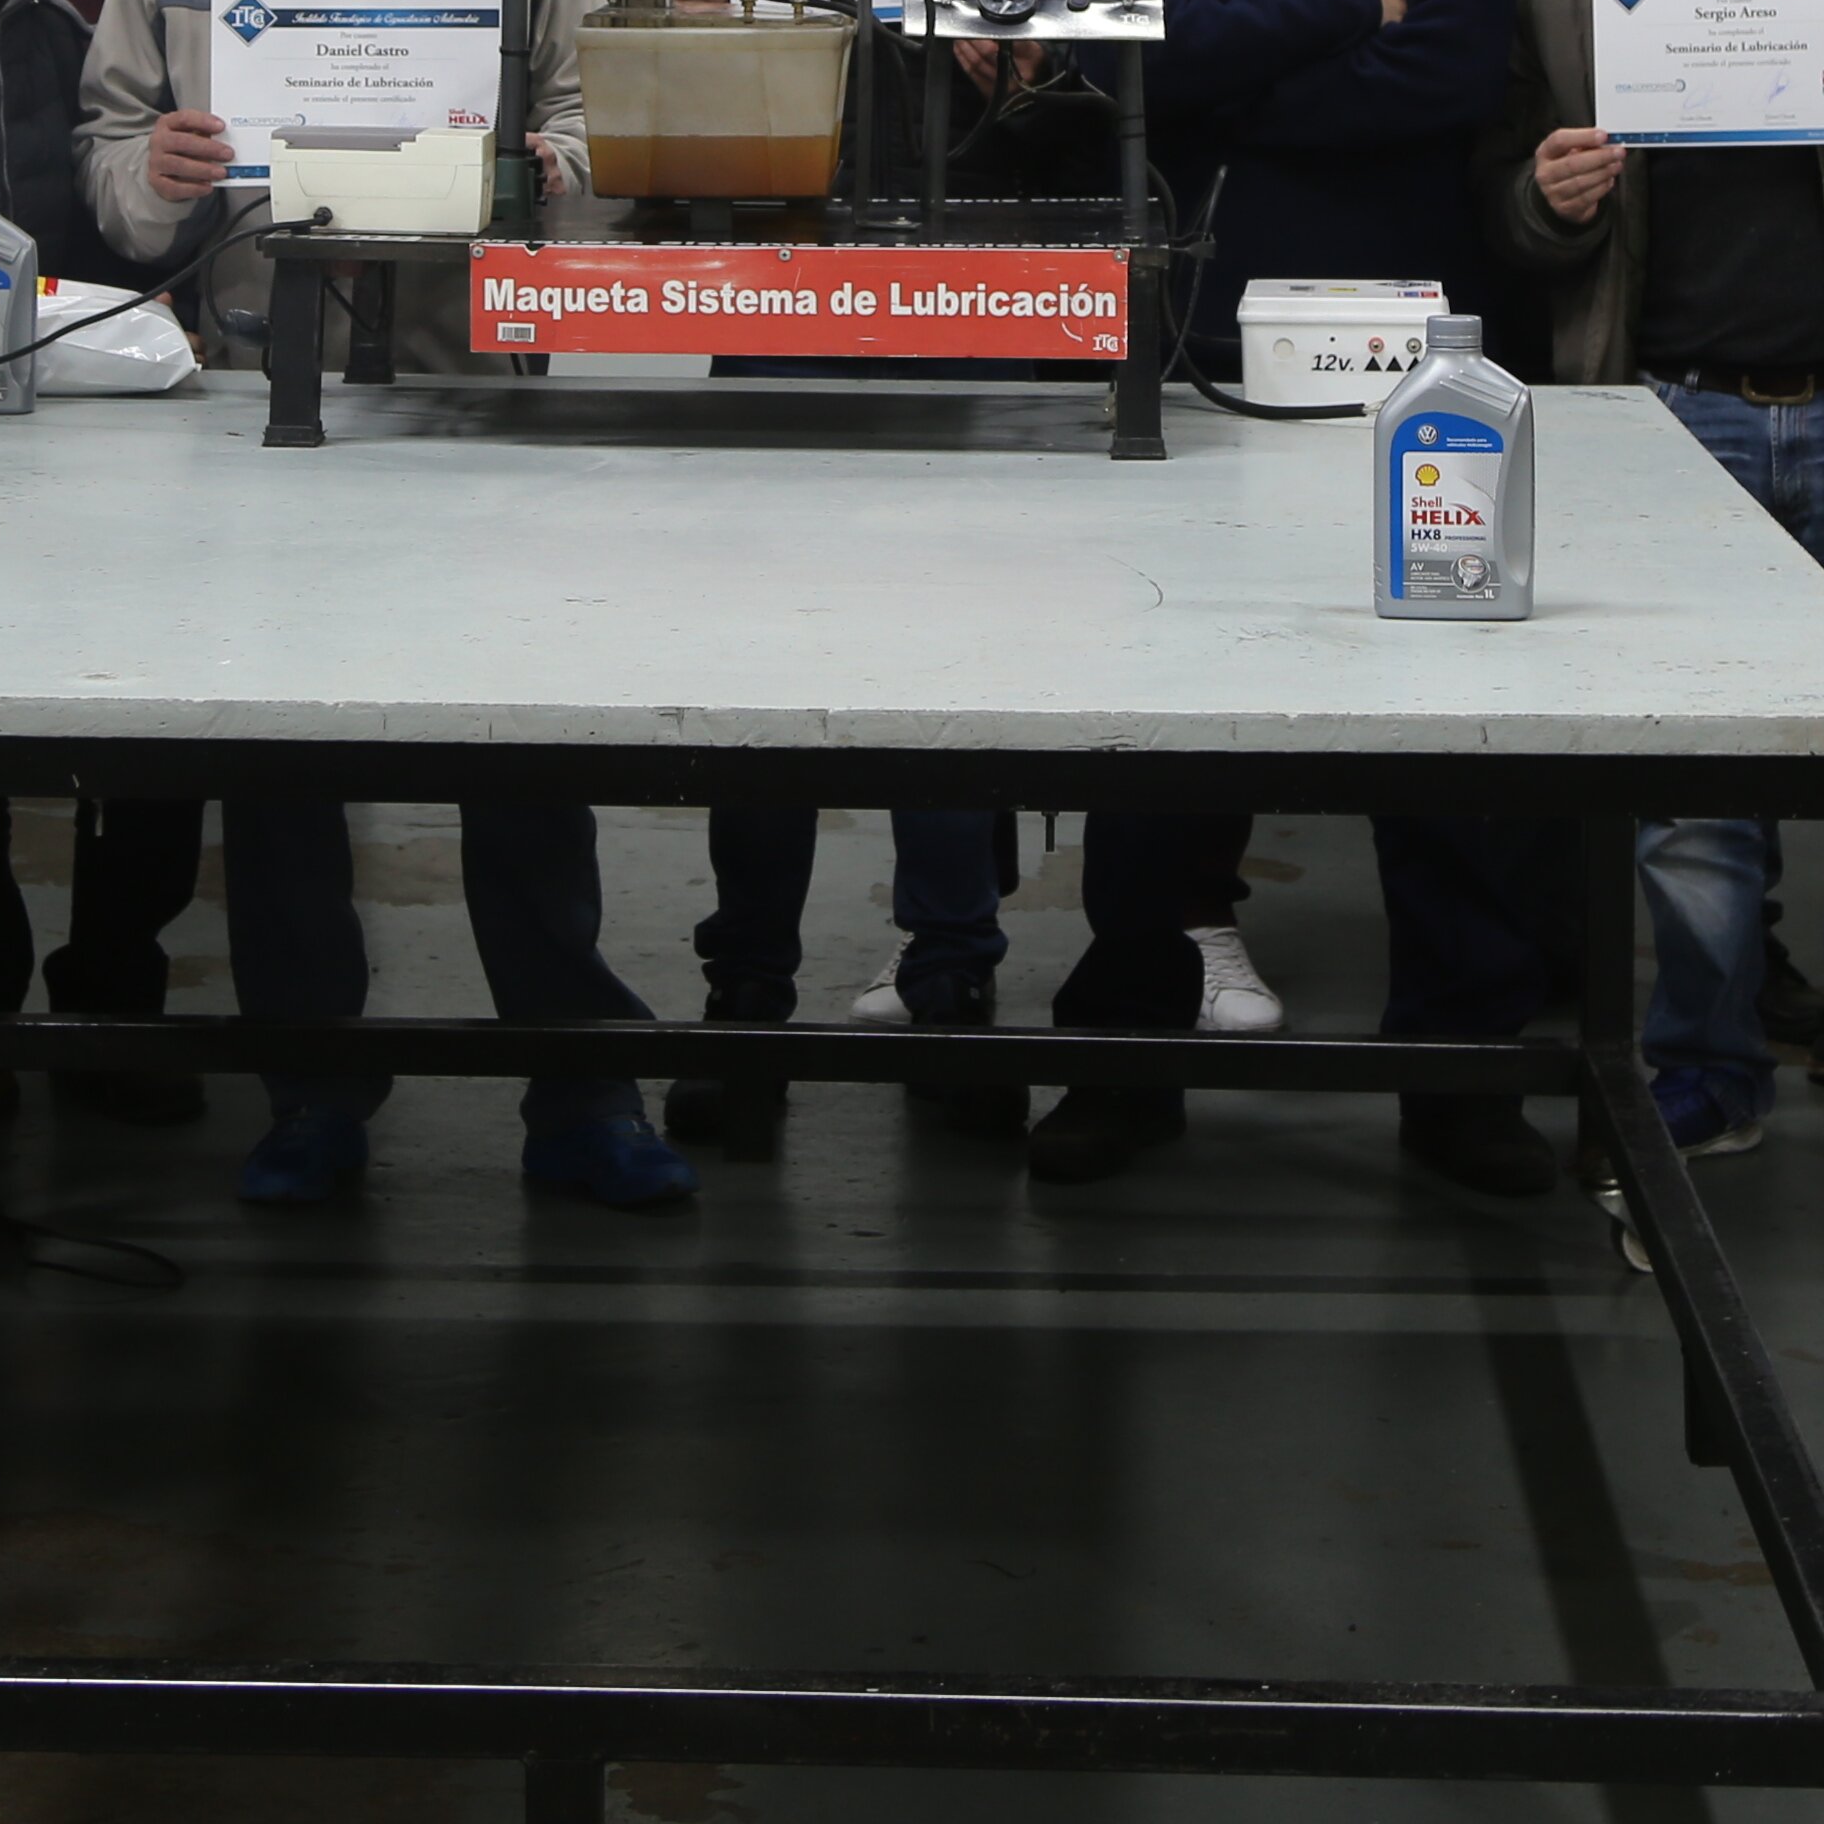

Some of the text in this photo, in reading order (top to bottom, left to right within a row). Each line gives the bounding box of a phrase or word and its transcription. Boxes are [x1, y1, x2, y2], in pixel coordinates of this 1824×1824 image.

[1695, 6, 1777, 22] Sergio Areso
[316, 44, 409, 57] Daniel Castro
[1665, 40, 1808, 54] Seminario de Lubricación
[285, 76, 434, 88] Seminario de Lubricación
[448, 114, 487, 124] HELIX
[483, 279, 1117, 320] Maqueta Sistema de Lubricación
[1311, 354, 1354, 371] 12v.
[1411, 497, 1442, 507] Shell
[1411, 510, 1486, 525] HELIX
[1411, 529, 1441, 541] HX8
[1410, 544, 1447, 553] 5W-40
[1410, 563, 1424, 571] AV
[1484, 589, 1494, 599] 1L
